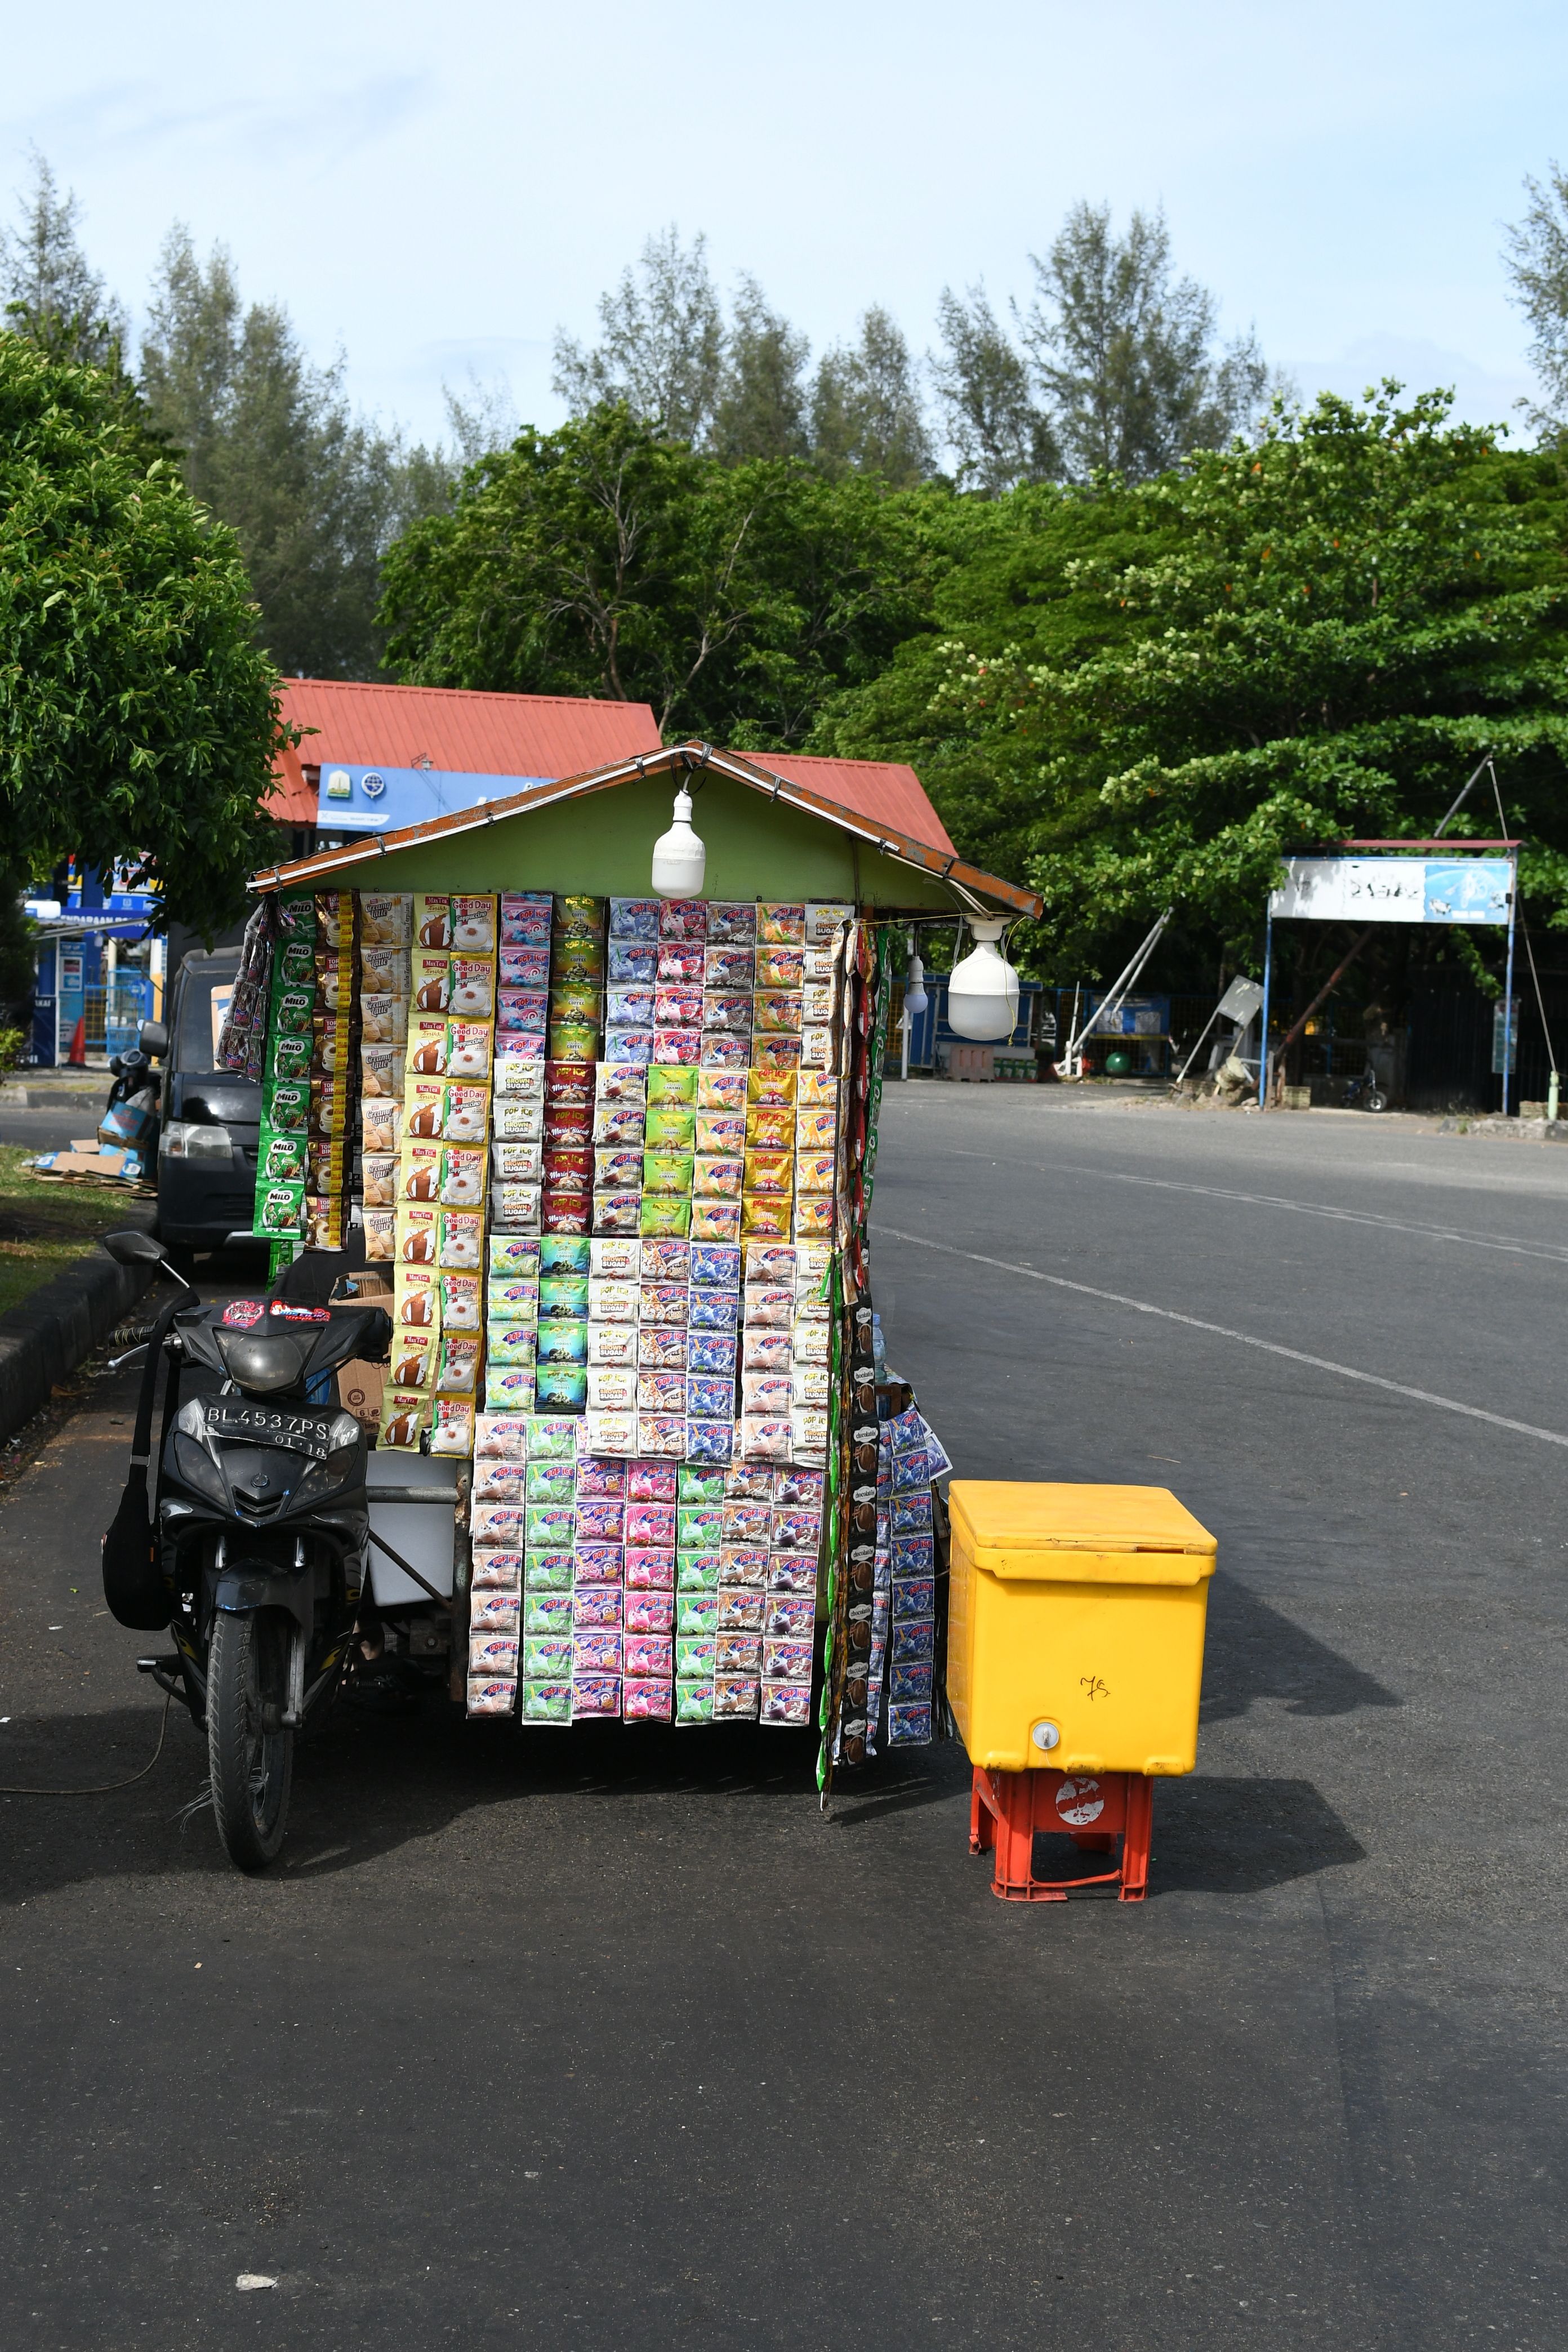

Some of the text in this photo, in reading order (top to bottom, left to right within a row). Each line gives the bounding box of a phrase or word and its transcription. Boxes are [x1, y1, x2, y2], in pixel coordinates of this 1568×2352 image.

[289, 903, 311, 912] MILO
[366, 902, 391, 911] Creamy
[452, 901, 491, 911] Good Day
[371, 908, 387, 917] Latte
[456, 911, 487, 922] Cappuccino
[288, 947, 309, 956] MILO
[366, 951, 391, 960] Creamy
[371, 957, 387, 966] Latte
[452, 964, 490, 973] Good Day
[455, 974, 486, 985] Cappuccino
[285, 997, 306, 1005] MILO
[366, 999, 391, 1008] Creamy
[371, 1006, 387, 1015] Latte
[451, 1027, 488, 1037] Good Day
[281, 1043, 302, 1052] MILO
[453, 1038, 484, 1048] Cappuccino
[366, 1053, 391, 1063] Creamy
[371, 1061, 387, 1070] Latte
[277, 1093, 298, 1102] MILO
[448, 1089, 484, 1099] Good Day
[450, 1101, 480, 1111] Cappuccino
[367, 1108, 393, 1118] Creamy
[372, 1116, 389, 1125] Latte
[446, 1153, 482, 1163] Good Day
[367, 1163, 393, 1173] Creamy
[448, 1164, 477, 1173] Cappuccino
[372, 1170, 389, 1180] Latte
[368, 1217, 393, 1226] Creamy
[444, 1216, 479, 1226] Good Day
[373, 1223, 390, 1232] Latte
[446, 1227, 475, 1236] Cappuccino
[443, 1278, 477, 1290] Good Day
[447, 1290, 472, 1299] Cappuccino
[445, 1341, 477, 1351] Good Day
[446, 1353, 472, 1362] Cappuccino
[436, 1404, 470, 1414] Good Day
[439, 1414, 465, 1423] Cappuccino
[208, 1408, 326, 1440] BL 4537 PS
